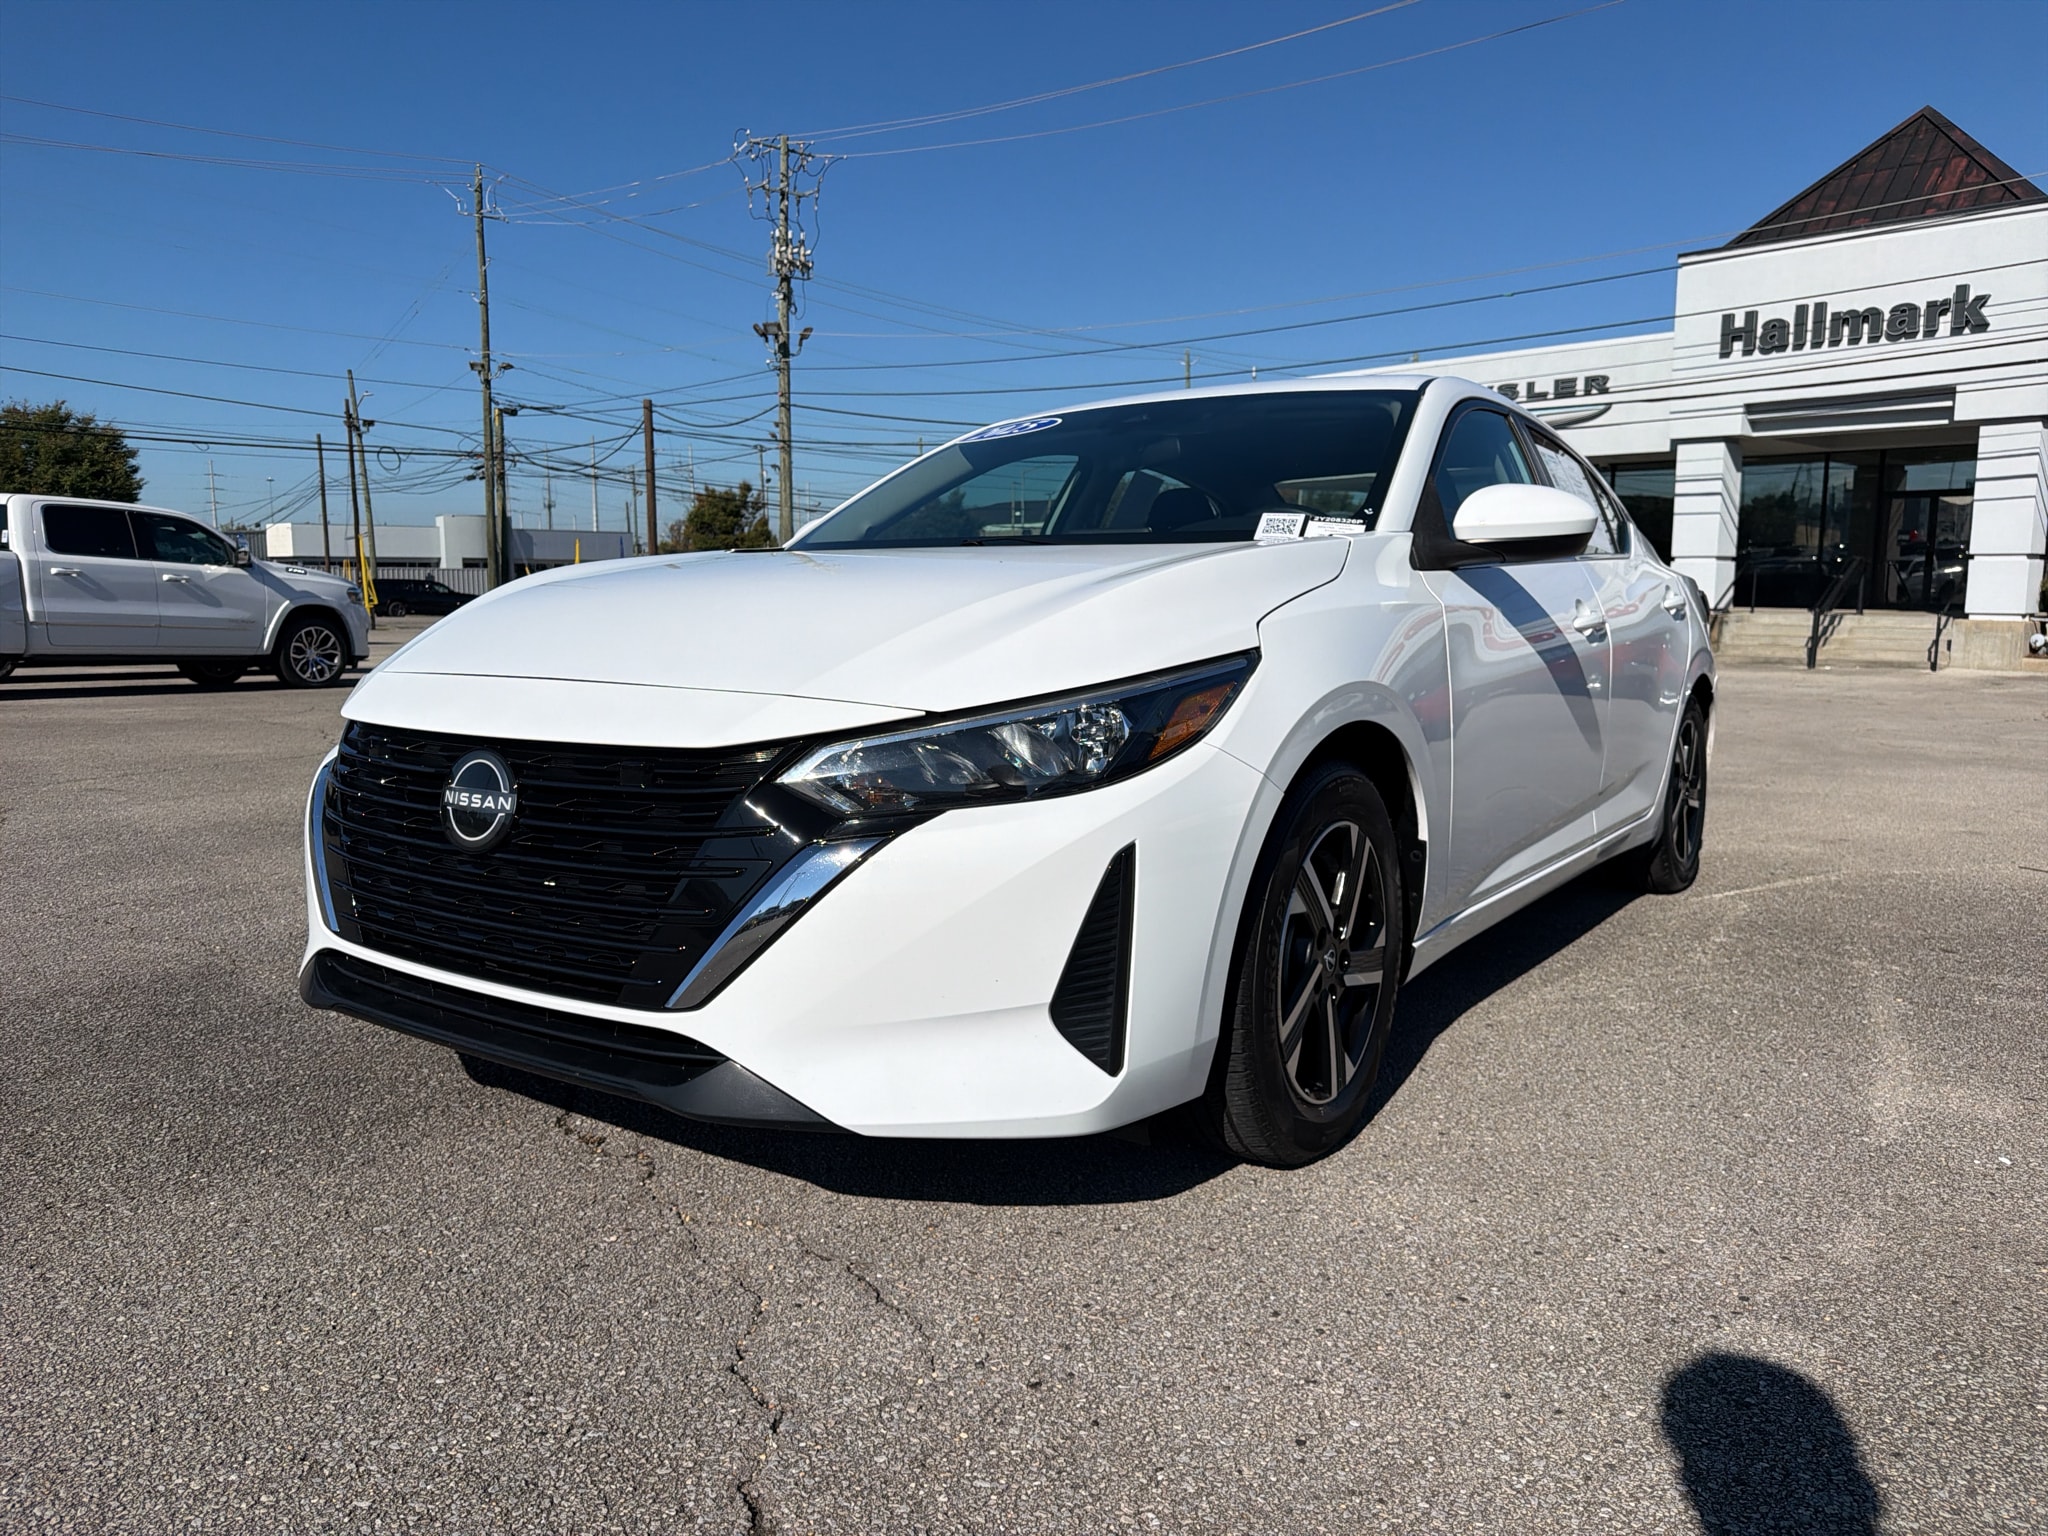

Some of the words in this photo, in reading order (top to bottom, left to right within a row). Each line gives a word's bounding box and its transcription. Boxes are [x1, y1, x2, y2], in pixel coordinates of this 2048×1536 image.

[1719, 283, 1991, 359] Hallmark
[1488, 375, 1610, 401] SLER
[444, 789, 512, 811] NISSAN
